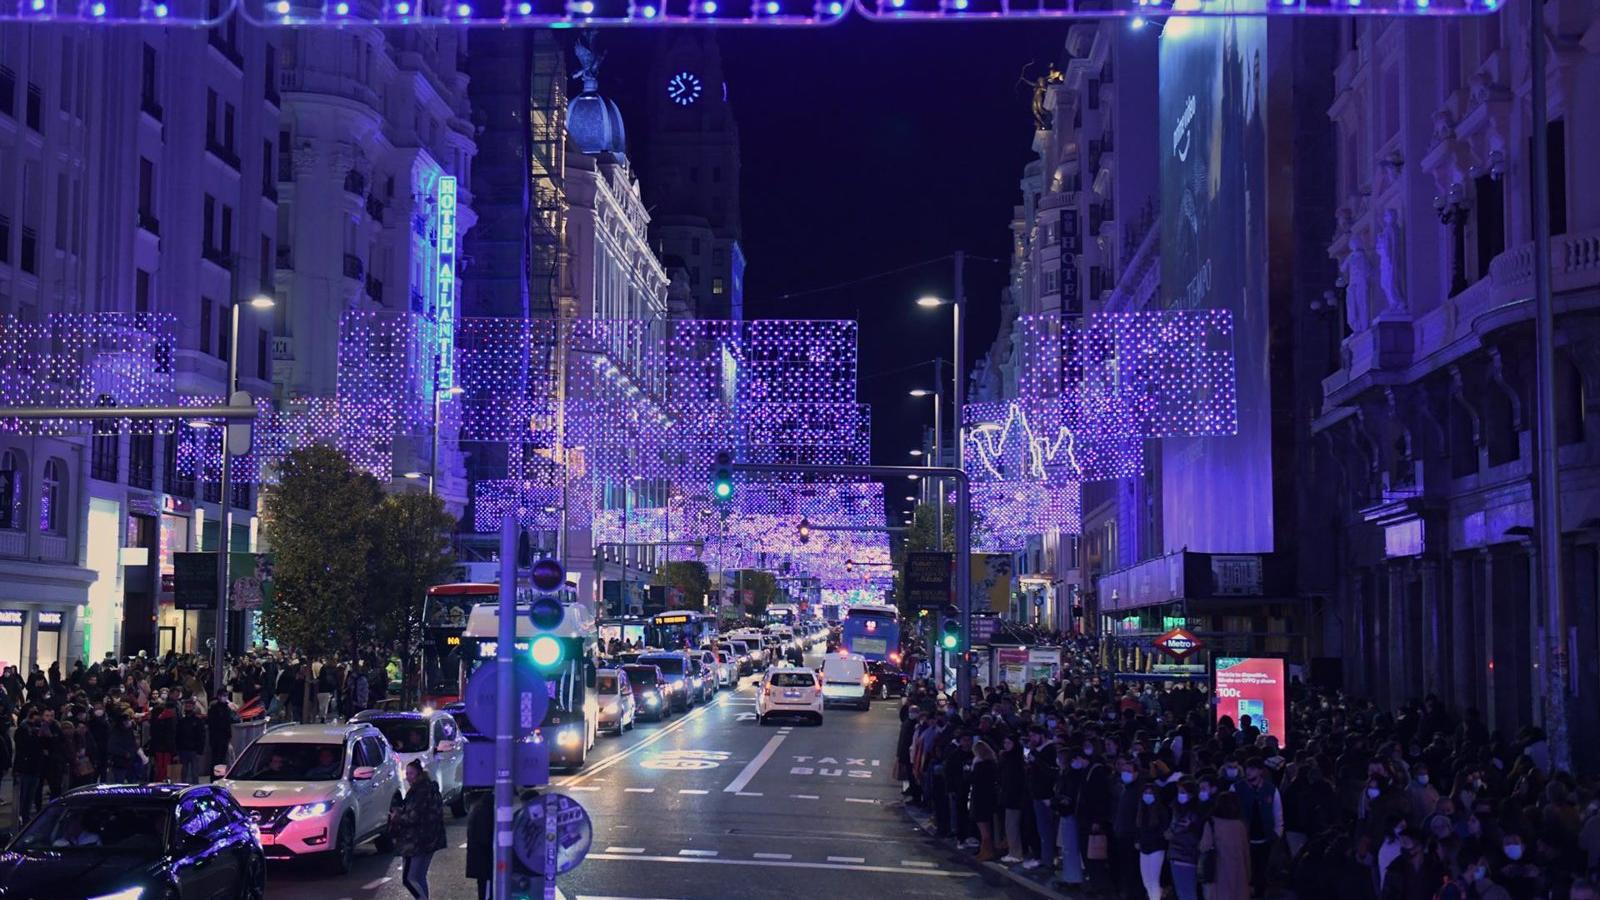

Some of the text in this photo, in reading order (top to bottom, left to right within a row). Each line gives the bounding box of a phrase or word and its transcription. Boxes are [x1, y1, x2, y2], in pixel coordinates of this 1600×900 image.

[440, 179, 455, 254] HOTEL
[1062, 237, 1077, 312] HOTEL
[1167, 639, 1191, 648] Metro
[791, 755, 880, 767] TAXI
[790, 767, 873, 778] BUS
